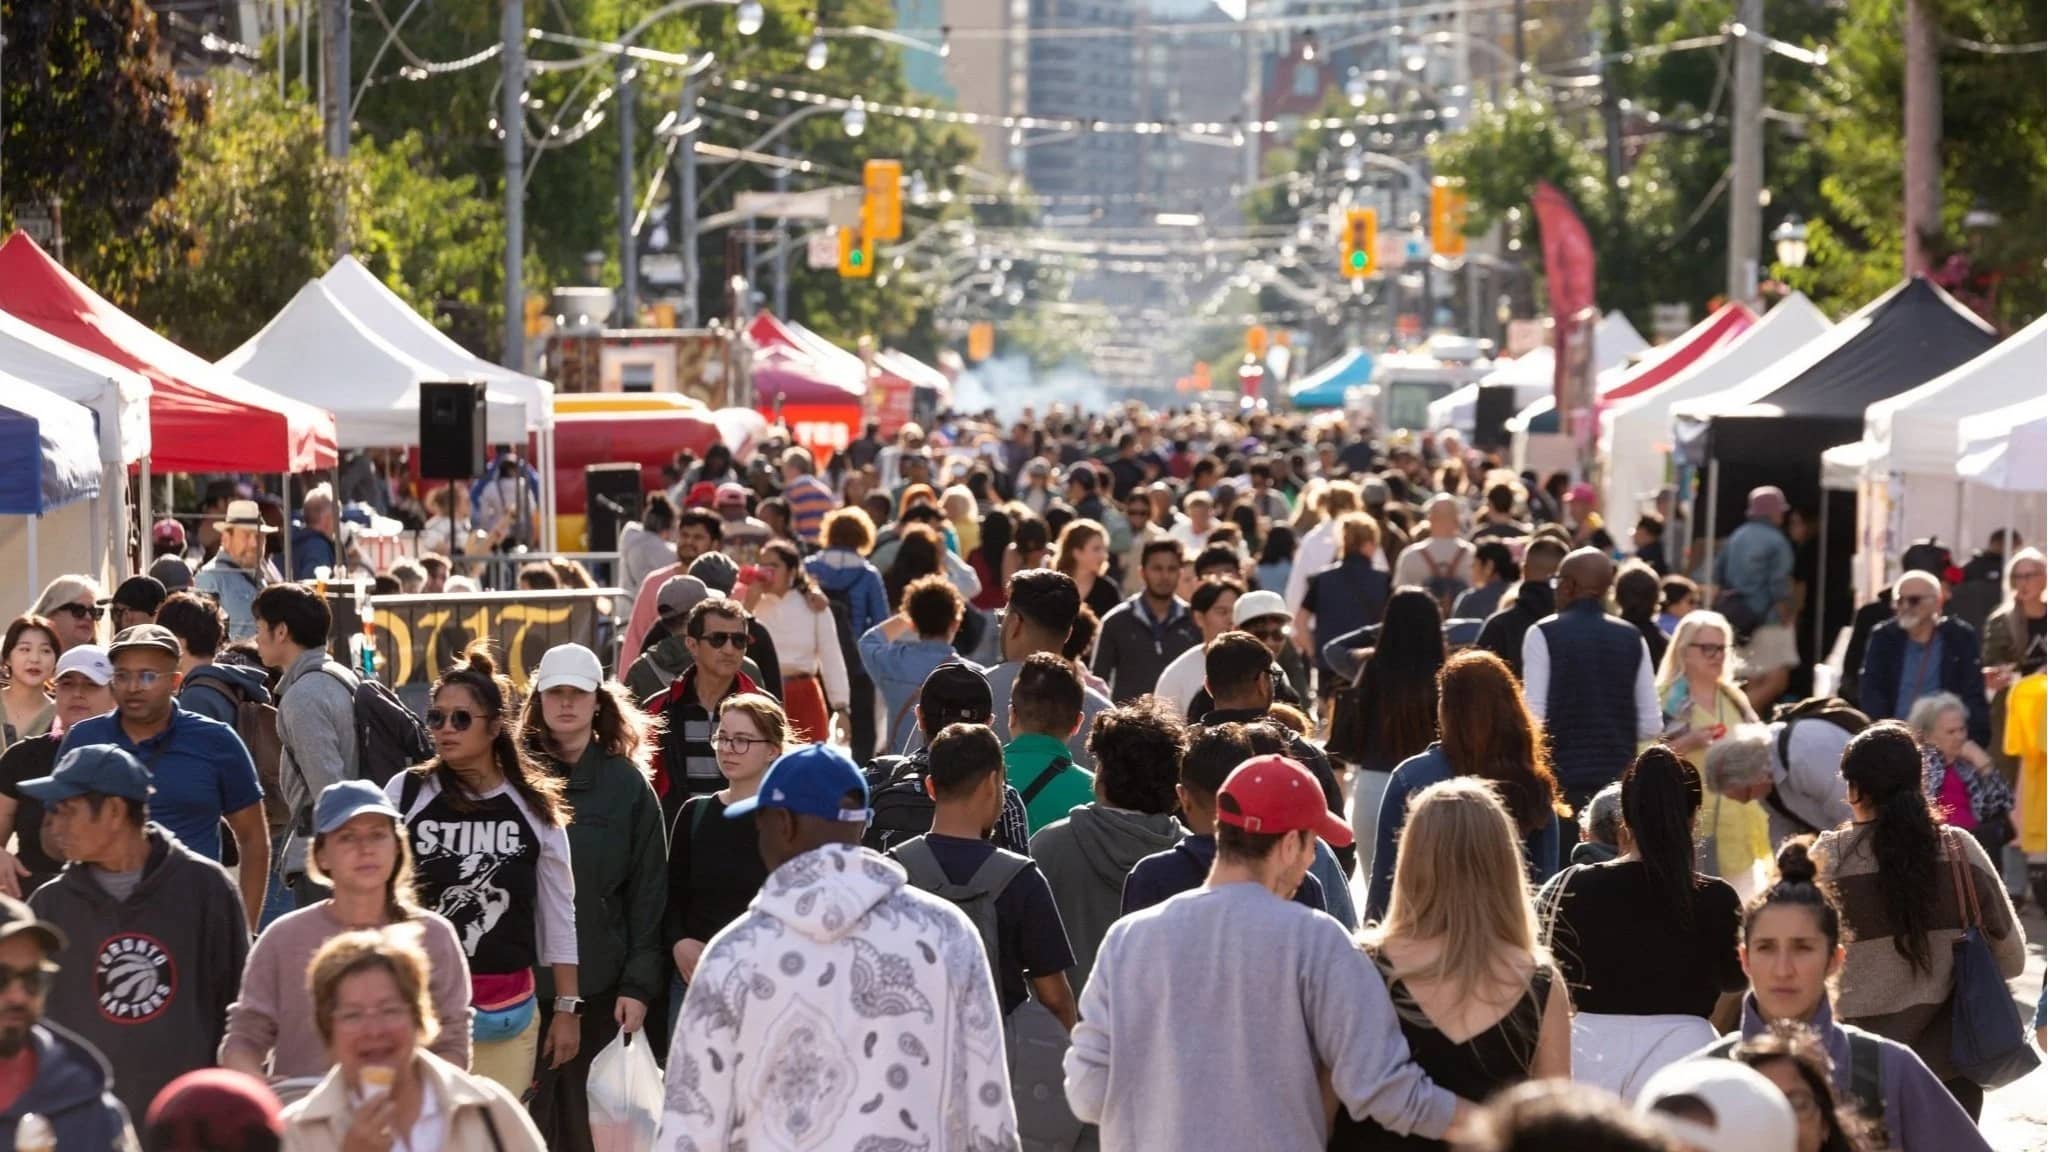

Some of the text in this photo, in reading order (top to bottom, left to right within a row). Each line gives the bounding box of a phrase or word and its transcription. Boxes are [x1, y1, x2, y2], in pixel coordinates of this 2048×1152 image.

[416, 820, 520, 855] STING
[96, 938, 168, 974] TORONTO
[99, 984, 171, 1018] RAPTORS
